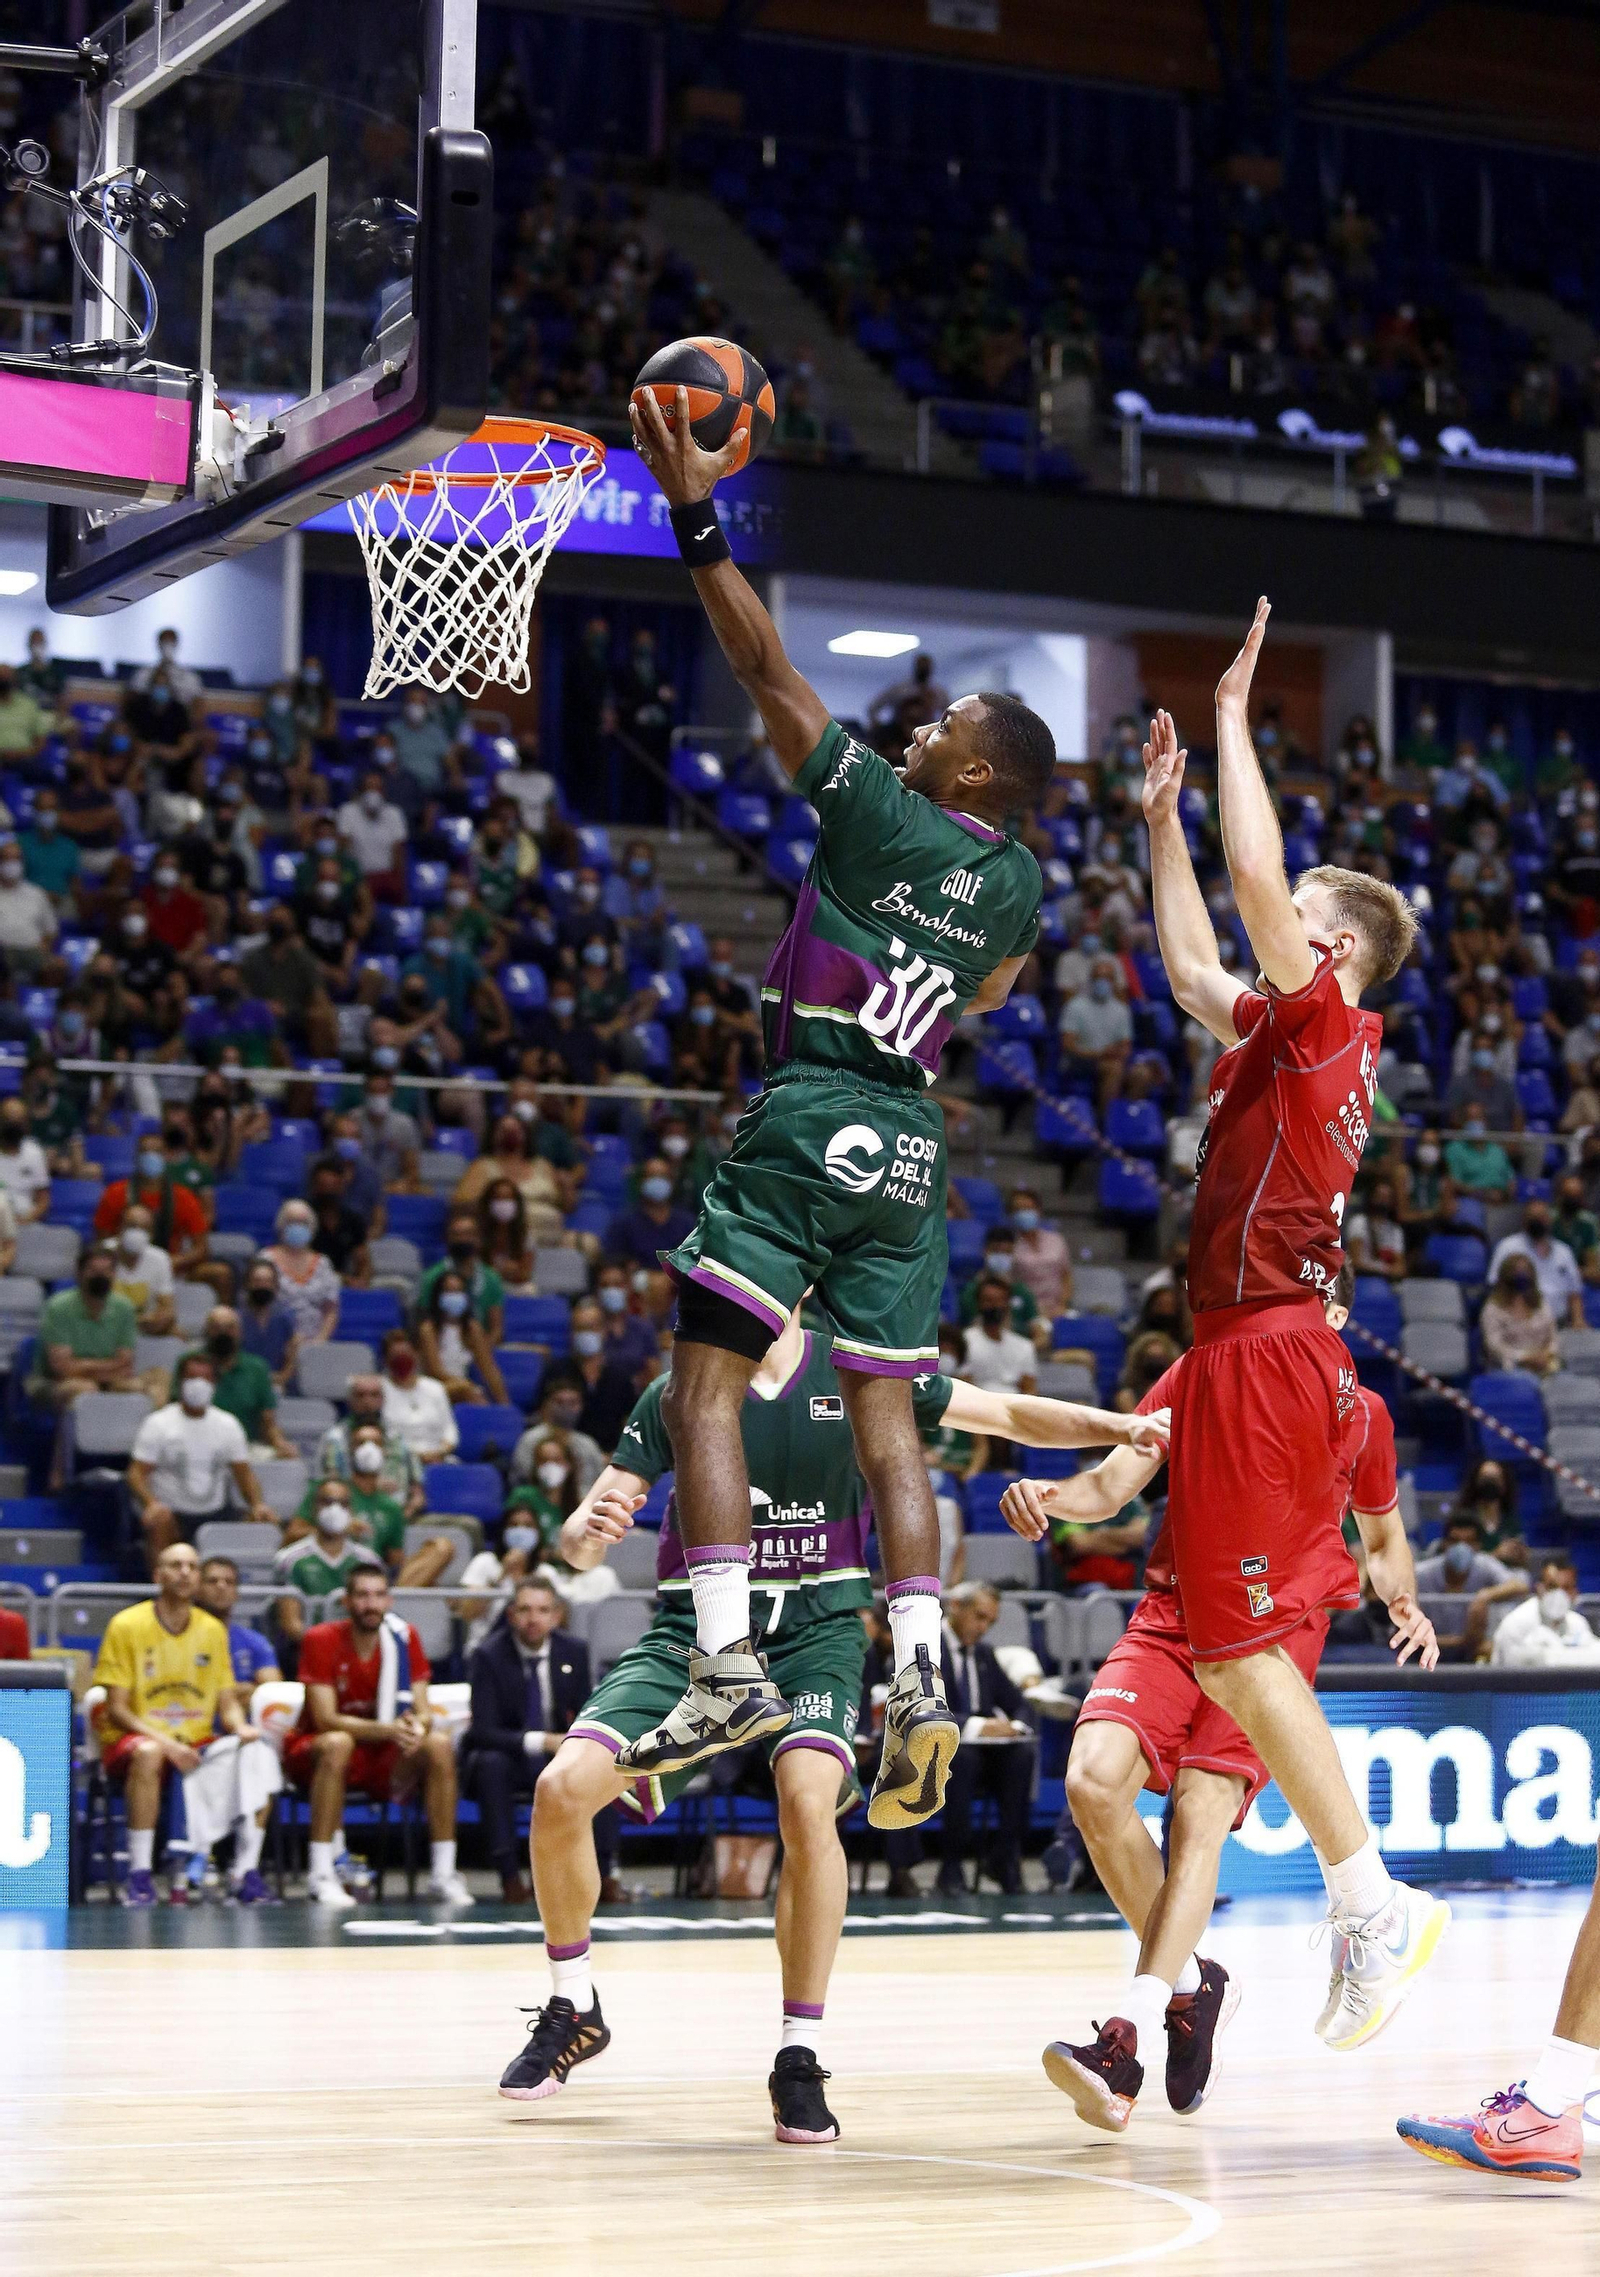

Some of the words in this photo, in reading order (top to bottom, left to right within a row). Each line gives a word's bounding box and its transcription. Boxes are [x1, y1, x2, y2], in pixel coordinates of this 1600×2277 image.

[940, 868, 984, 906] COLE
[858, 935, 958, 1057] 30
[890, 1159, 920, 1183] DEL
[767, 1500, 826, 1521] Unicaa
[1244, 1563, 1262, 1573] acb
[765, 1589, 786, 1635] 7
